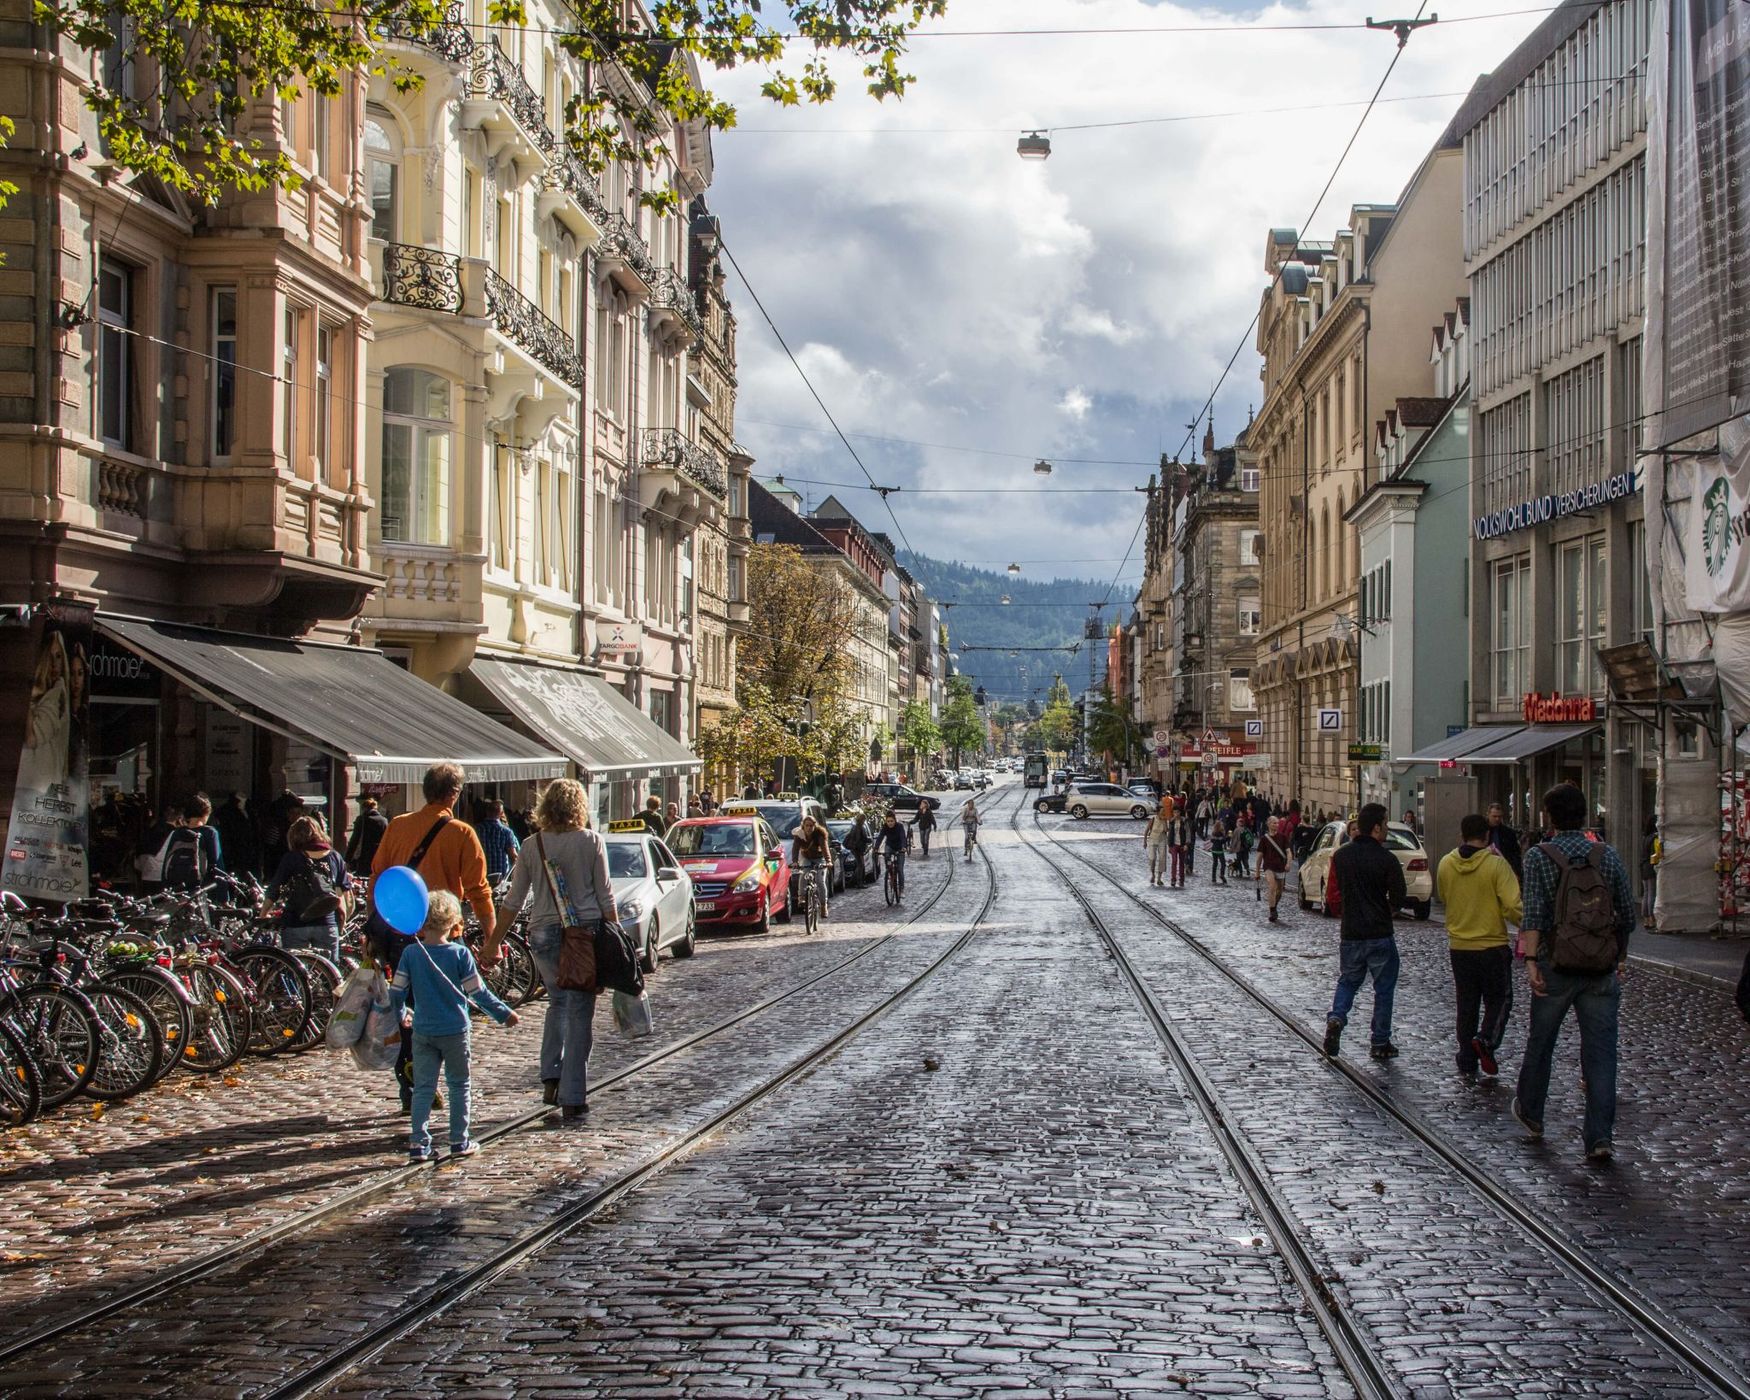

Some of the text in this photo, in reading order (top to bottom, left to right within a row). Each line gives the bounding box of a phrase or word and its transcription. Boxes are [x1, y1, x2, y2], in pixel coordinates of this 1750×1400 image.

[1474, 473, 1630, 541] VOLKSWOHL BUND VERSICHERUNGEN
[1523, 692, 1596, 722] Madonna
[35, 797, 77, 816] HERBST
[613, 820, 640, 829] TAXI
[71, 858, 82, 868] Lee
